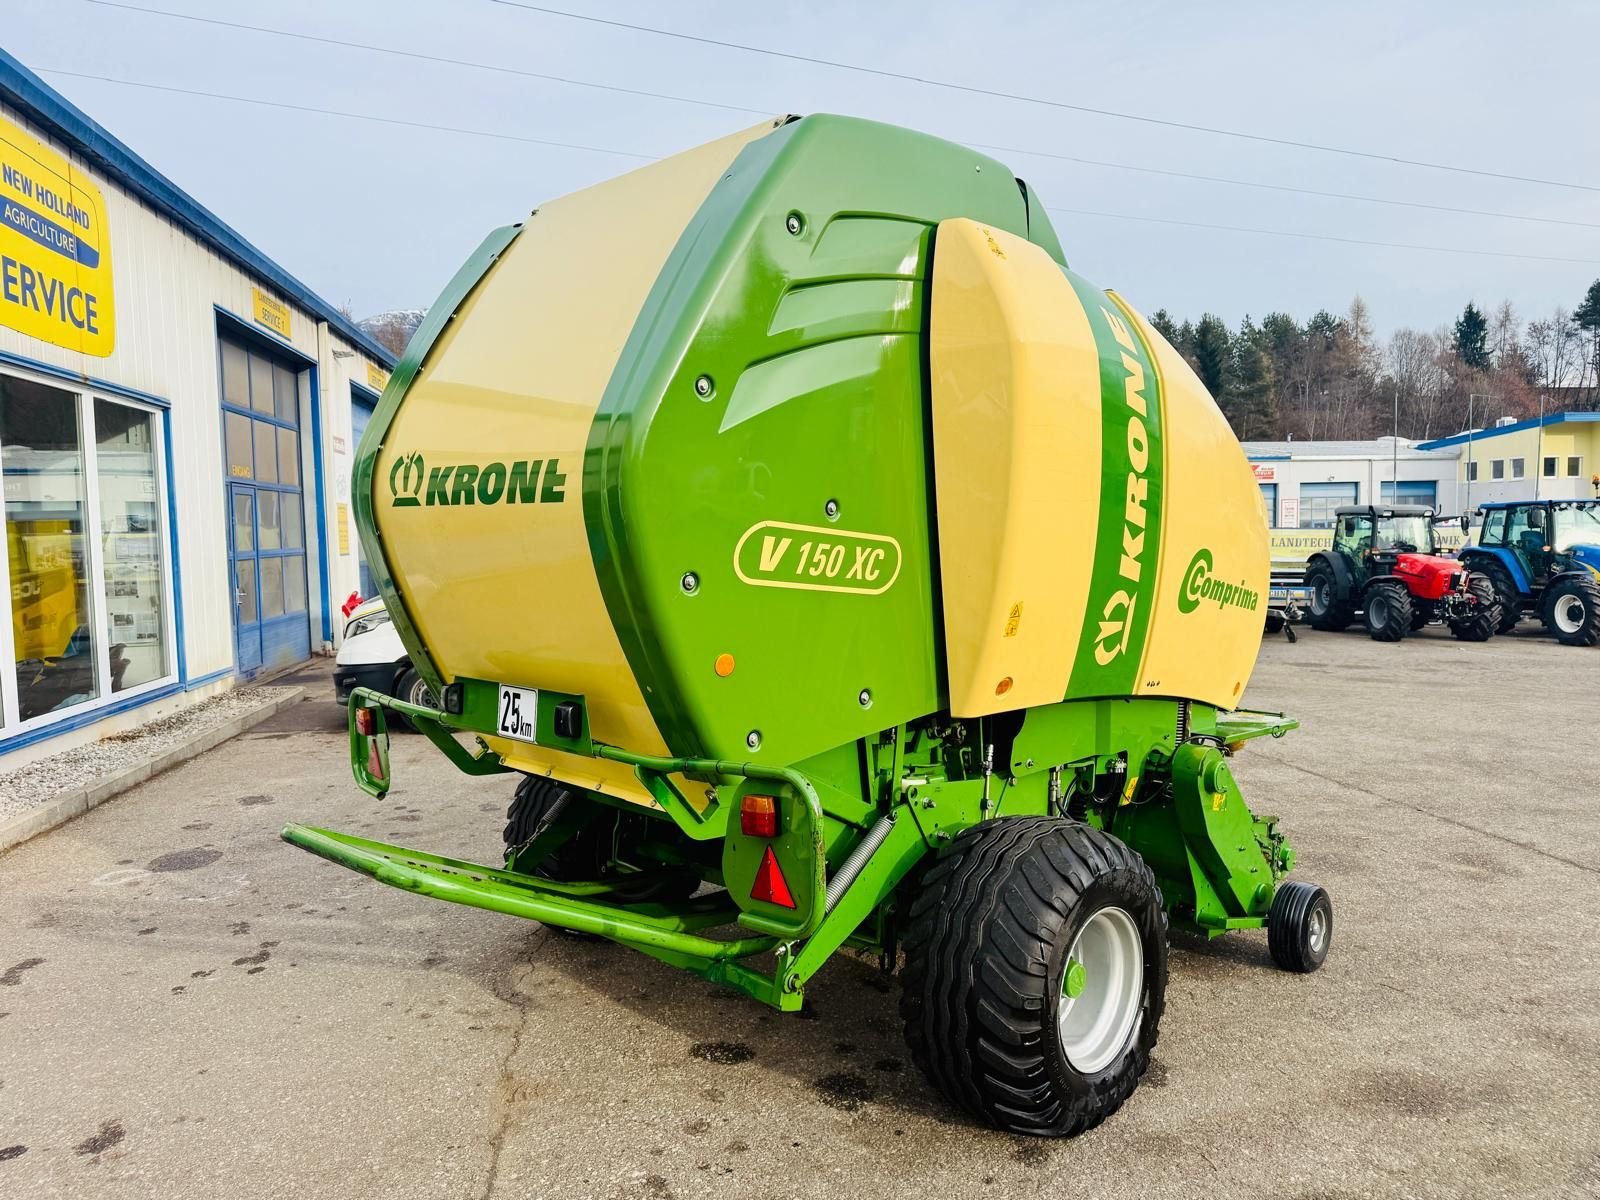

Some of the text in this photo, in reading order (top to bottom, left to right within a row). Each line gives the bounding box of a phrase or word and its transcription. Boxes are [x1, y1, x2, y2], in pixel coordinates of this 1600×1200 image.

[2, 163, 90, 230] NEW HOLLAND
[4, 203, 75, 254] AGRICULTURE
[1, 255, 99, 335] ERVICE
[1100, 305, 1149, 583] KRONE
[425, 458, 567, 506] KRONE
[759, 535, 885, 581] V 150 XC
[1271, 537, 1332, 548] LANDTECH
[1178, 548, 1258, 614] Comprima
[501, 690, 532, 738] 25 km
